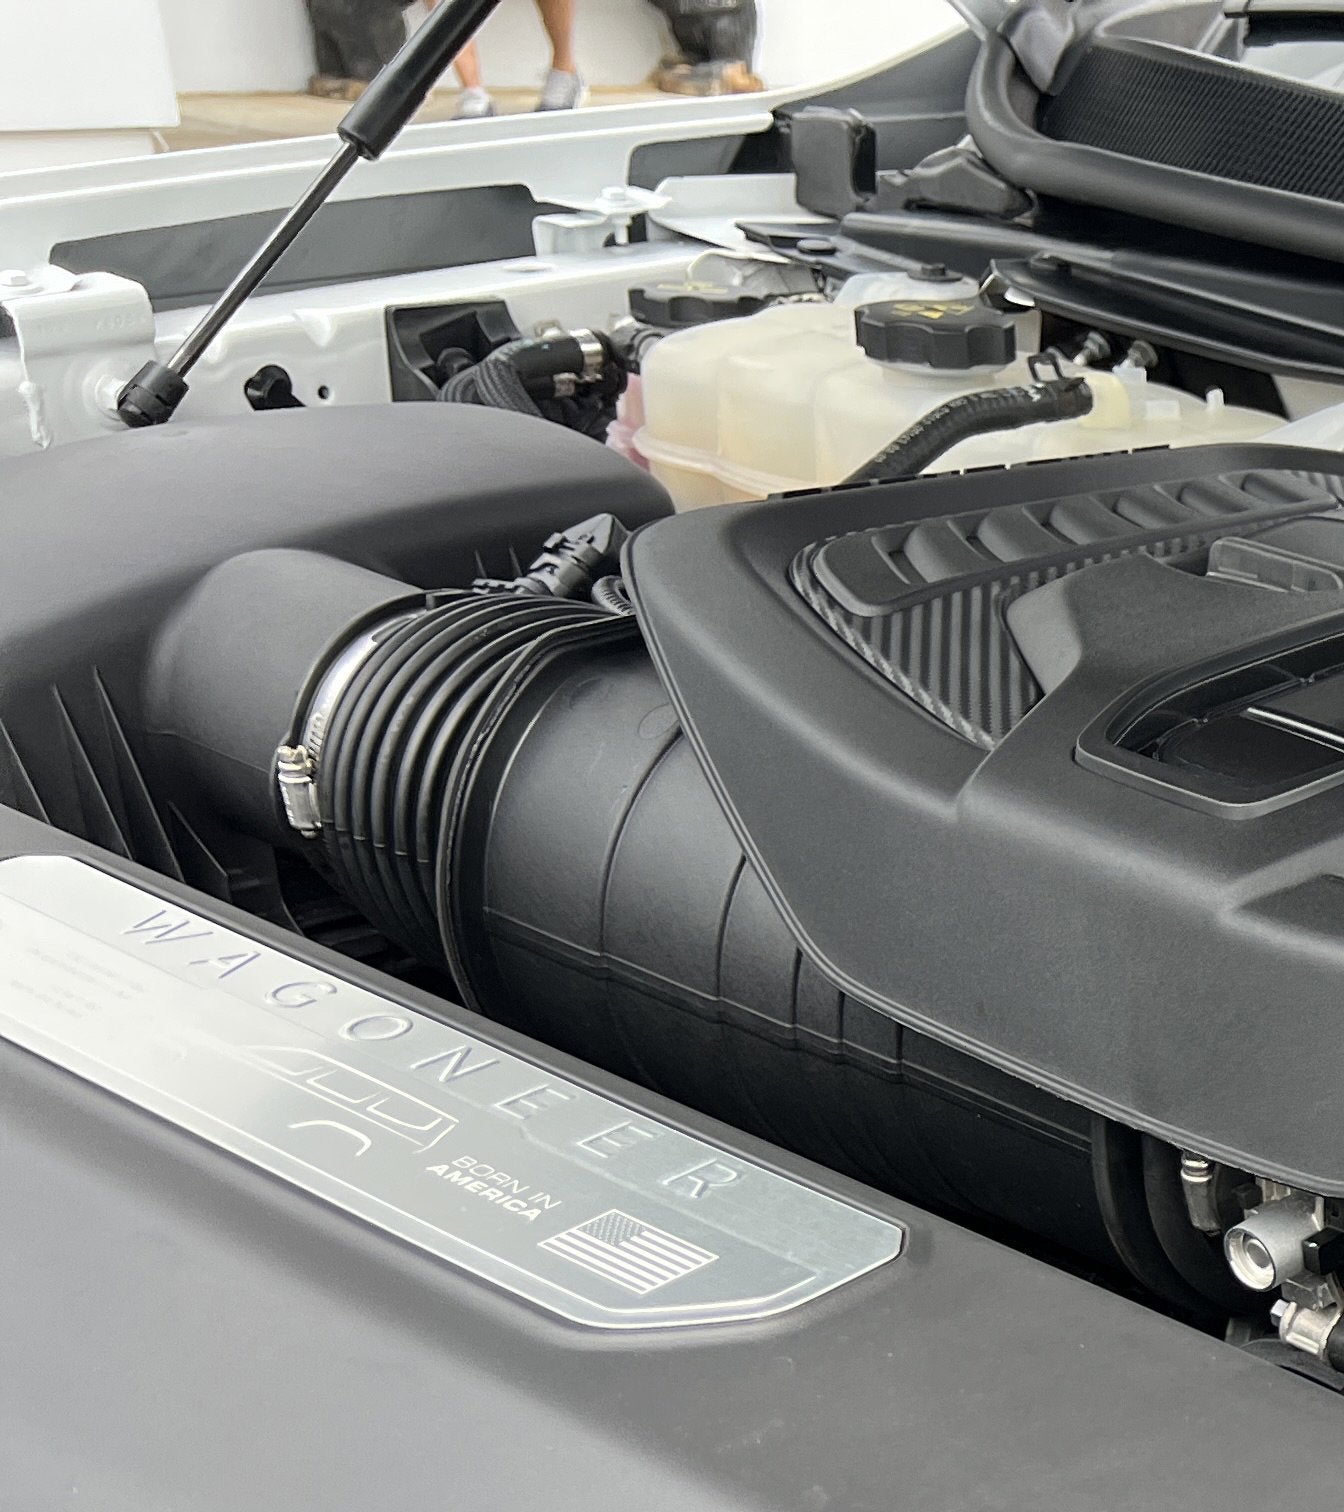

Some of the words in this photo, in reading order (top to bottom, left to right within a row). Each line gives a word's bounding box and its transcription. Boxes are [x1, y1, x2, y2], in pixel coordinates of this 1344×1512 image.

[121, 905, 742, 1201] WAGONEER
[425, 1163, 542, 1222] AMERICA
[452, 1154, 531, 1194] BORN
[527, 1191, 562, 1210] IN
